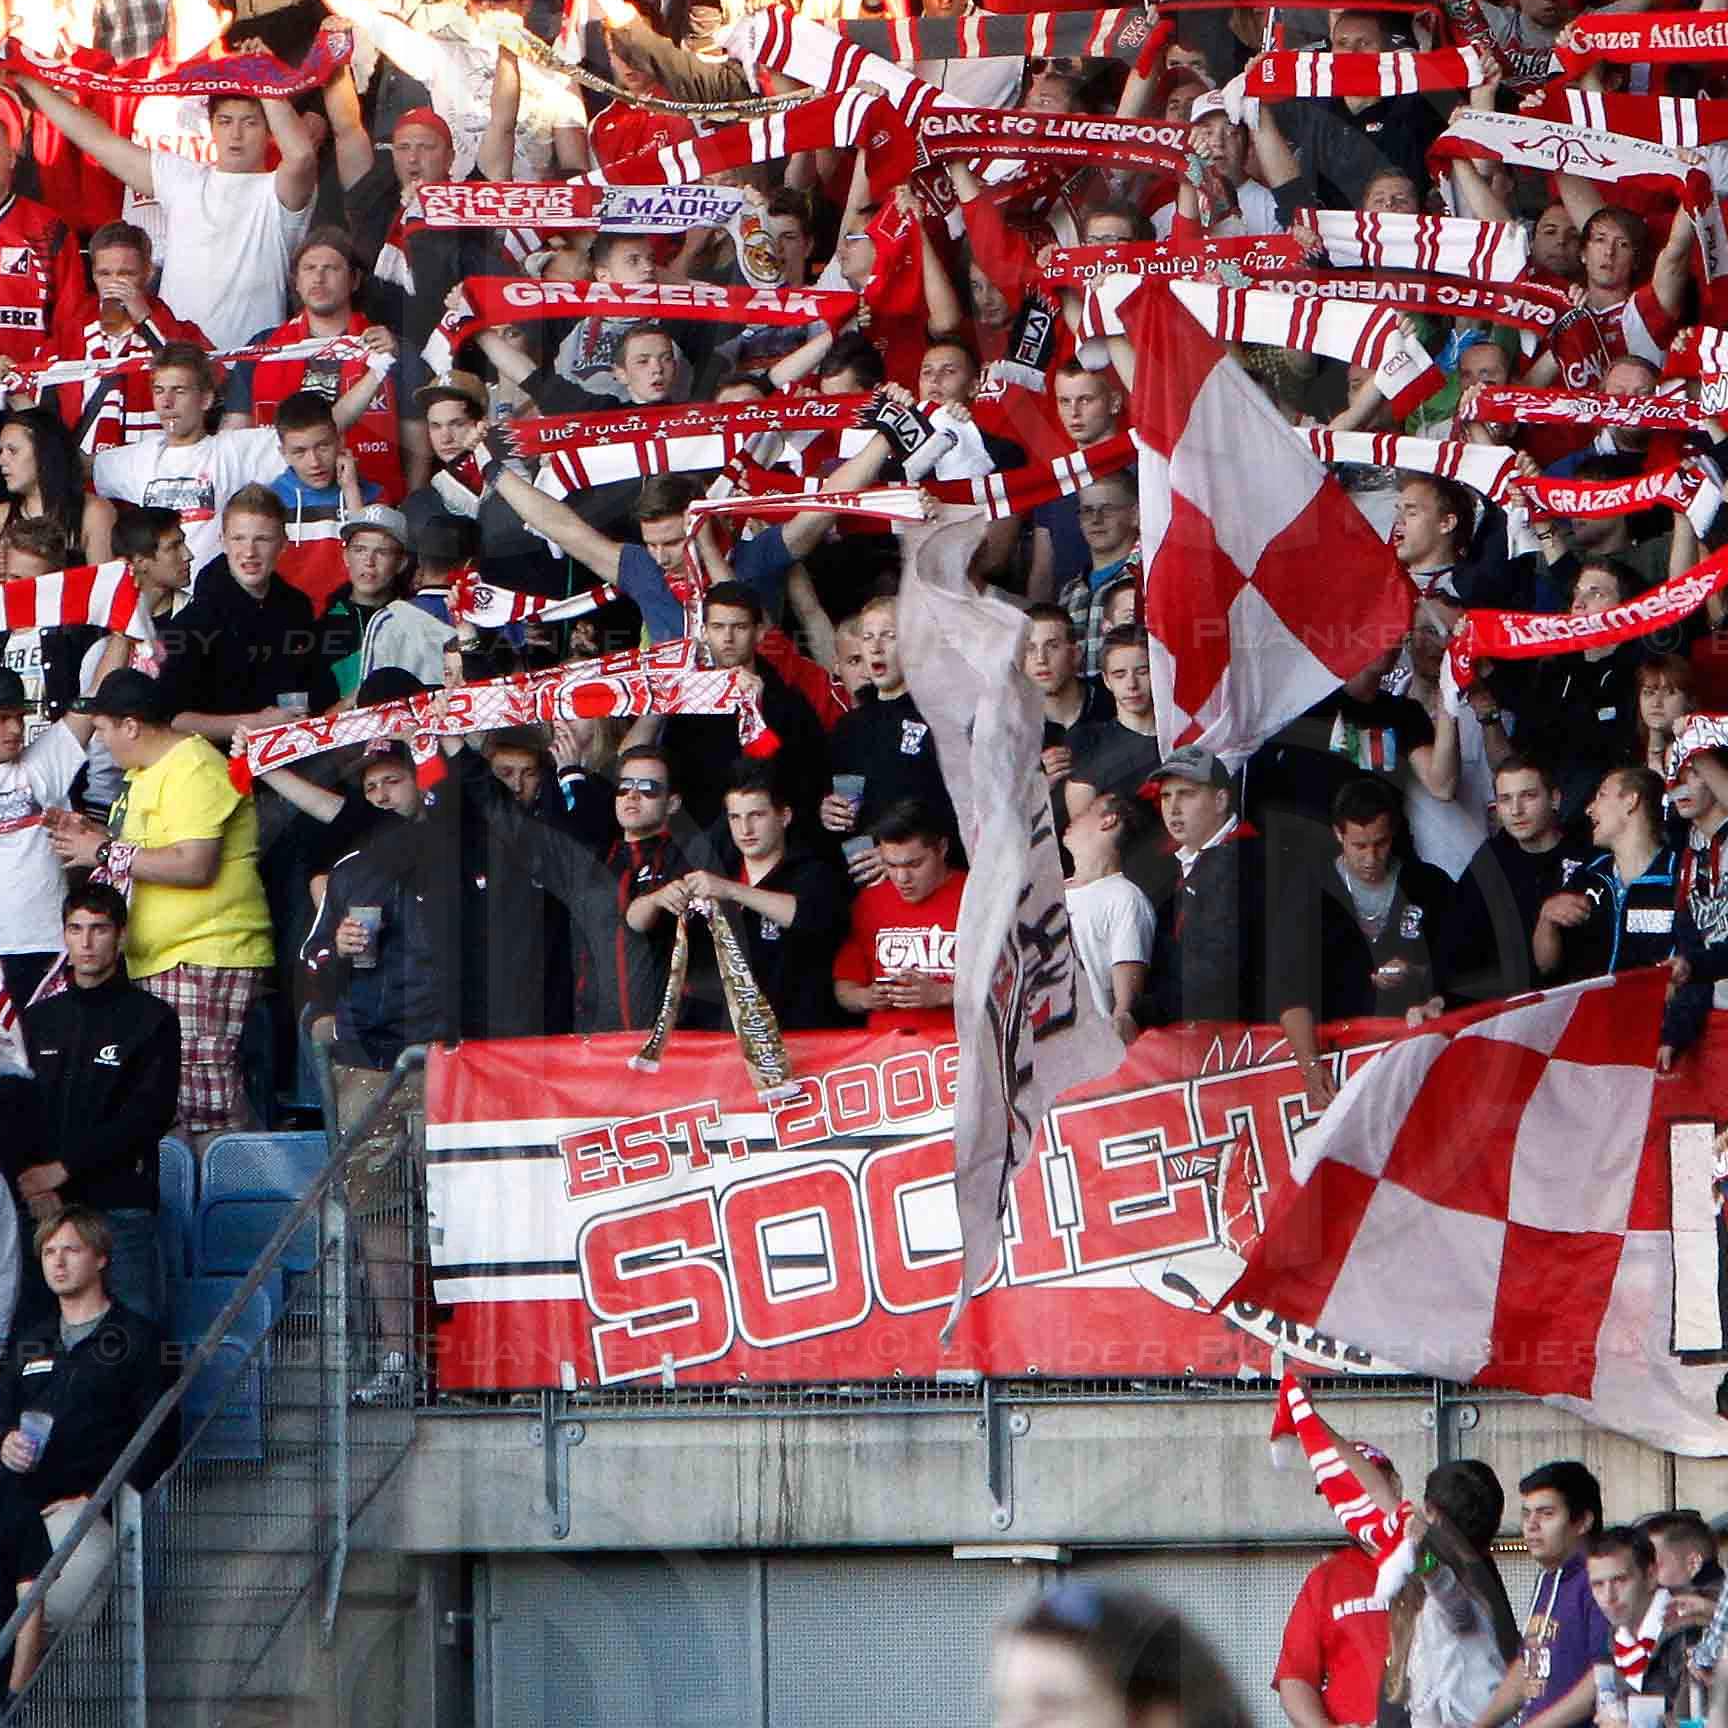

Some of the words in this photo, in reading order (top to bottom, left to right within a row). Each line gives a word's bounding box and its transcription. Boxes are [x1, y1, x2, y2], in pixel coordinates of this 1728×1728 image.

[1567, 27, 1642, 55] Grazer
[924, 115, 985, 137] GAK
[1000, 118, 1036, 136] FC
[1044, 118, 1186, 151] LIVERPOOL
[1541, 123, 1620, 146] Athletik
[419, 185, 573, 197] GRAZER
[422, 196, 574, 207] ATHLETIK
[660, 186, 722, 198] REAL
[419, 206, 575, 218] KLUB
[1071, 256, 1130, 278] roten
[1241, 249, 1287, 271] Graz
[502, 280, 729, 309] GRAZER
[744, 288, 820, 317] AK
[1257, 278, 1427, 303] LIVERPOOL
[1436, 288, 1478, 306] FC
[1496, 297, 1558, 325] GAK
[1547, 484, 1630, 515] GRAZER
[557, 1099, 751, 1202] EST.
